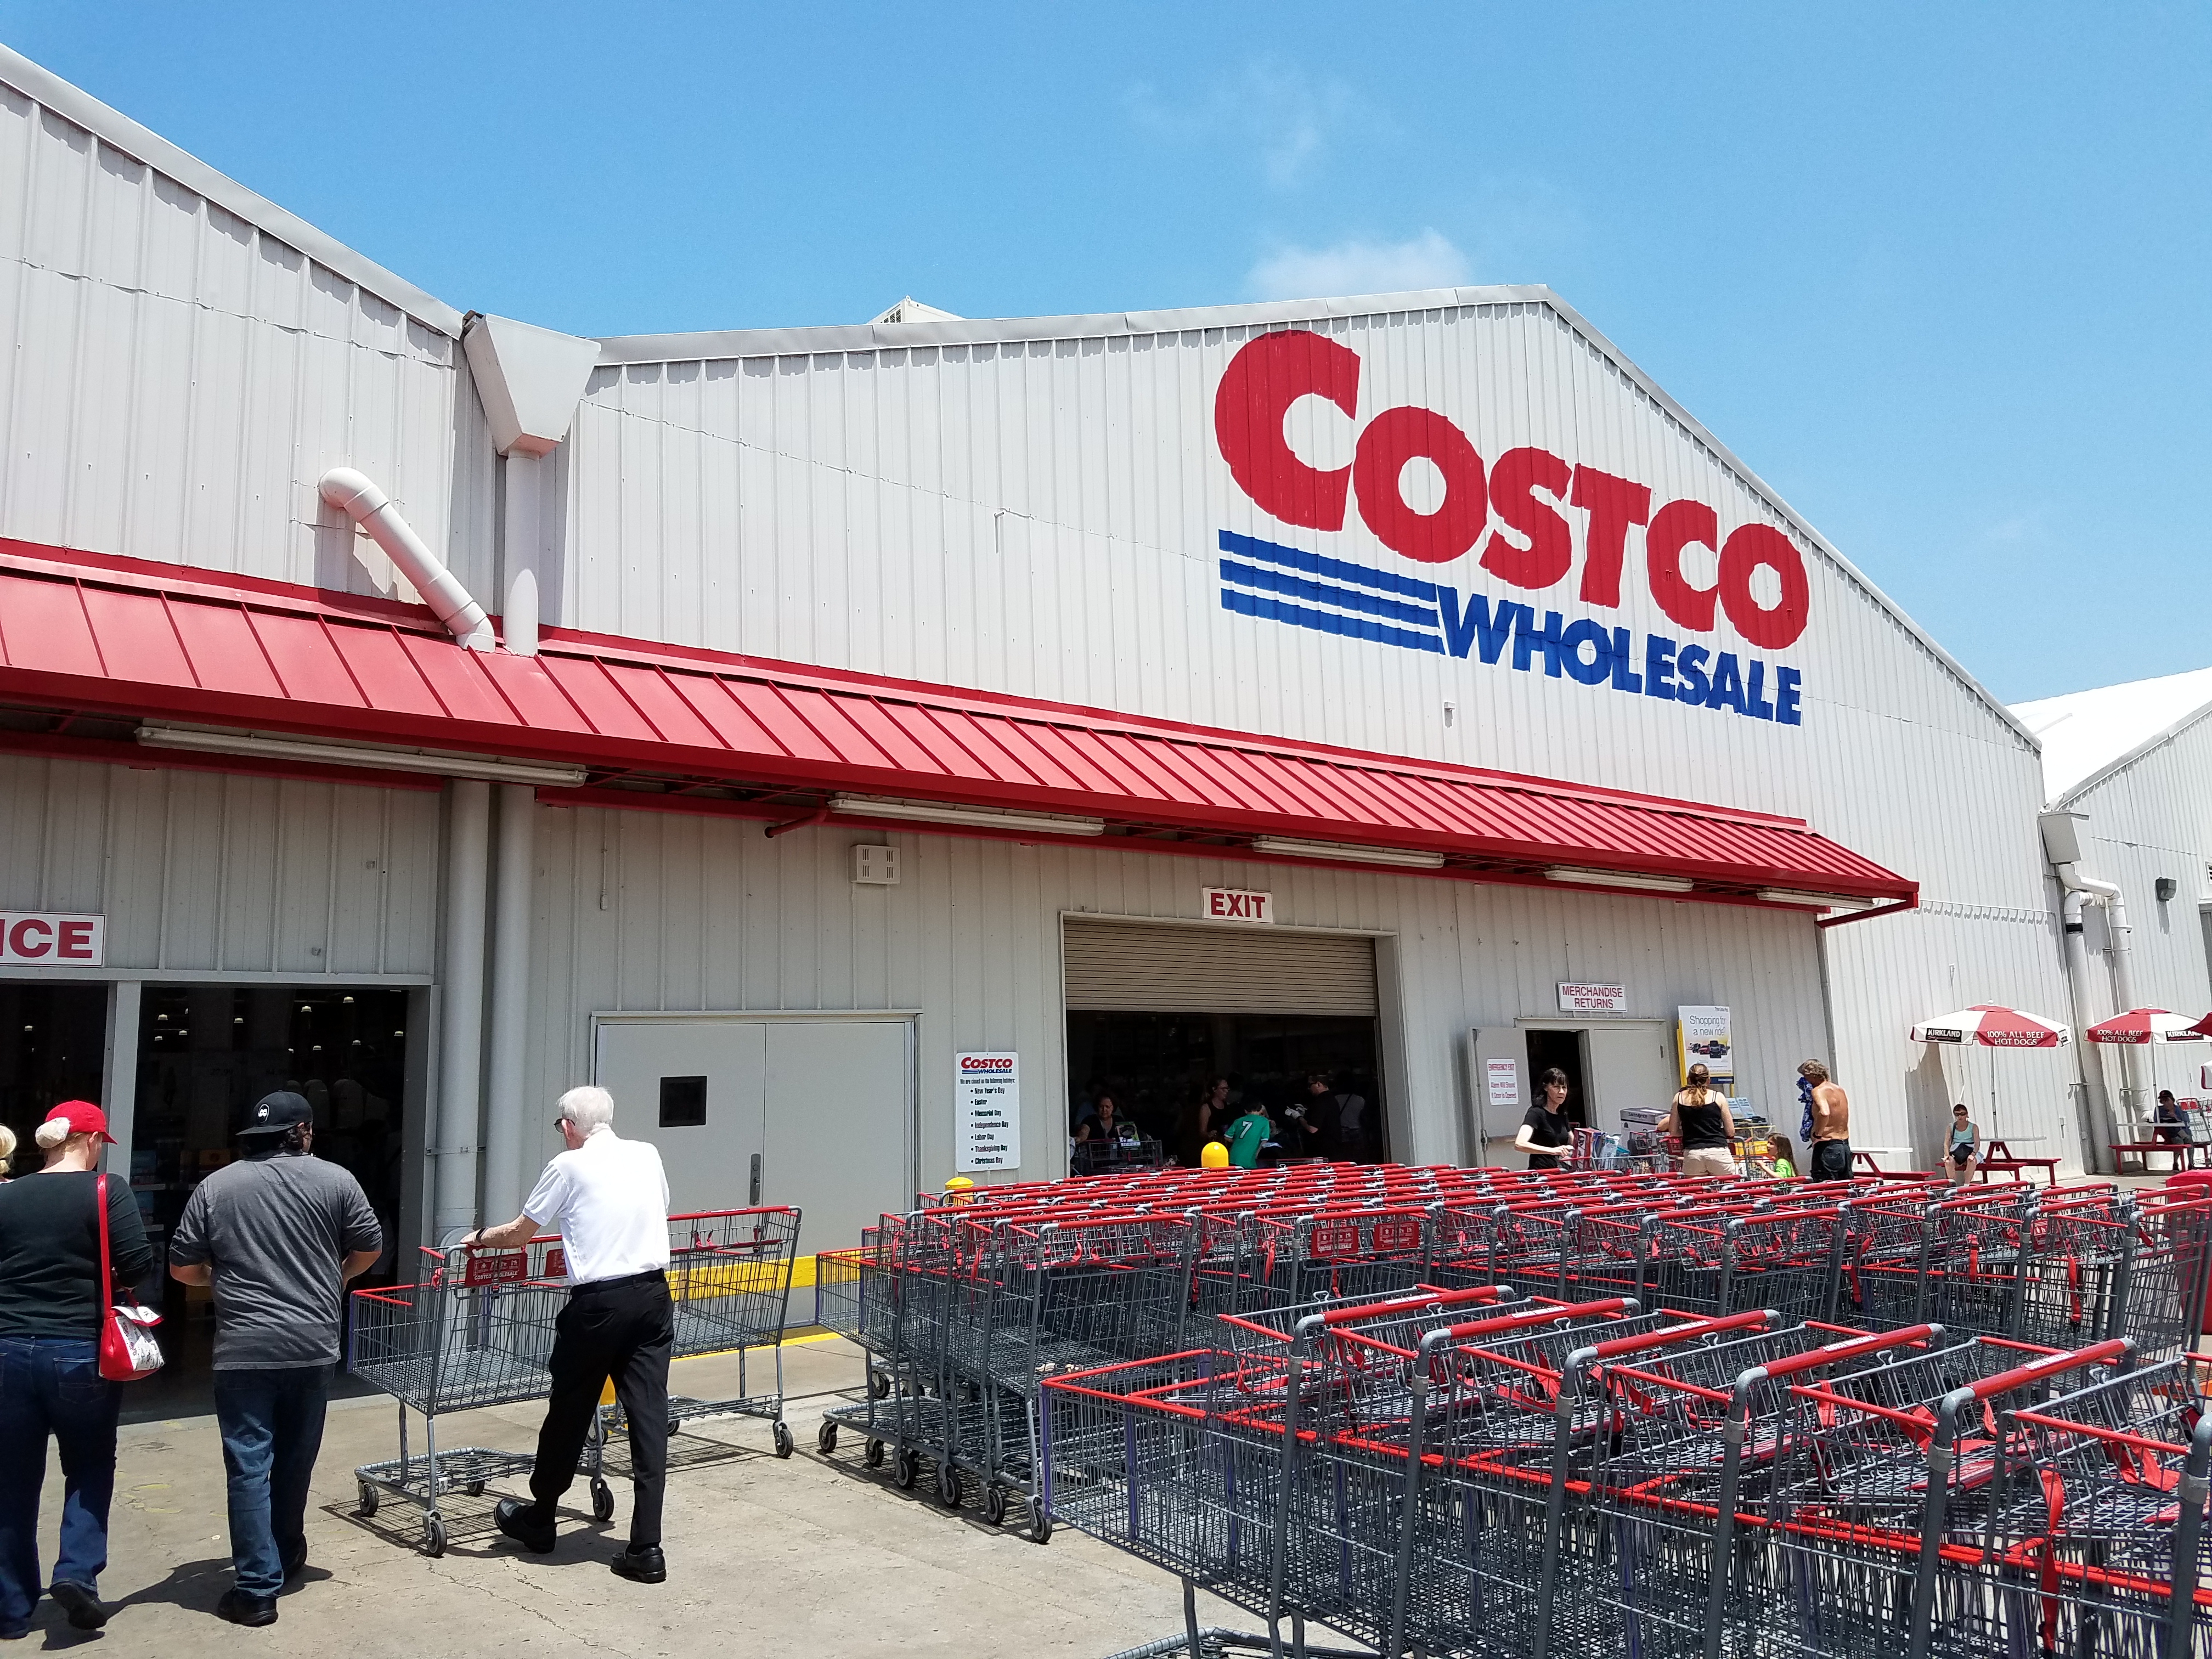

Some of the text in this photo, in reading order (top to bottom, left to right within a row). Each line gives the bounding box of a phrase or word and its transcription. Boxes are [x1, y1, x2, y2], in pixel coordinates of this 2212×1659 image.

[1215, 329, 1809, 649] COSTCO
[1435, 583, 1801, 726] WHOLESALE
[1210, 893, 1265, 918] EXIT
[0, 919, 93, 958] CE
[1562, 985, 1623, 997] MERCHANDISE
[1575, 997, 1613, 1008] RETURNS
[1690, 1015, 1720, 1026] Shopping
[961, 1057, 1013, 1069] COSTCO
[1240, 1121, 1253, 1139] 7
